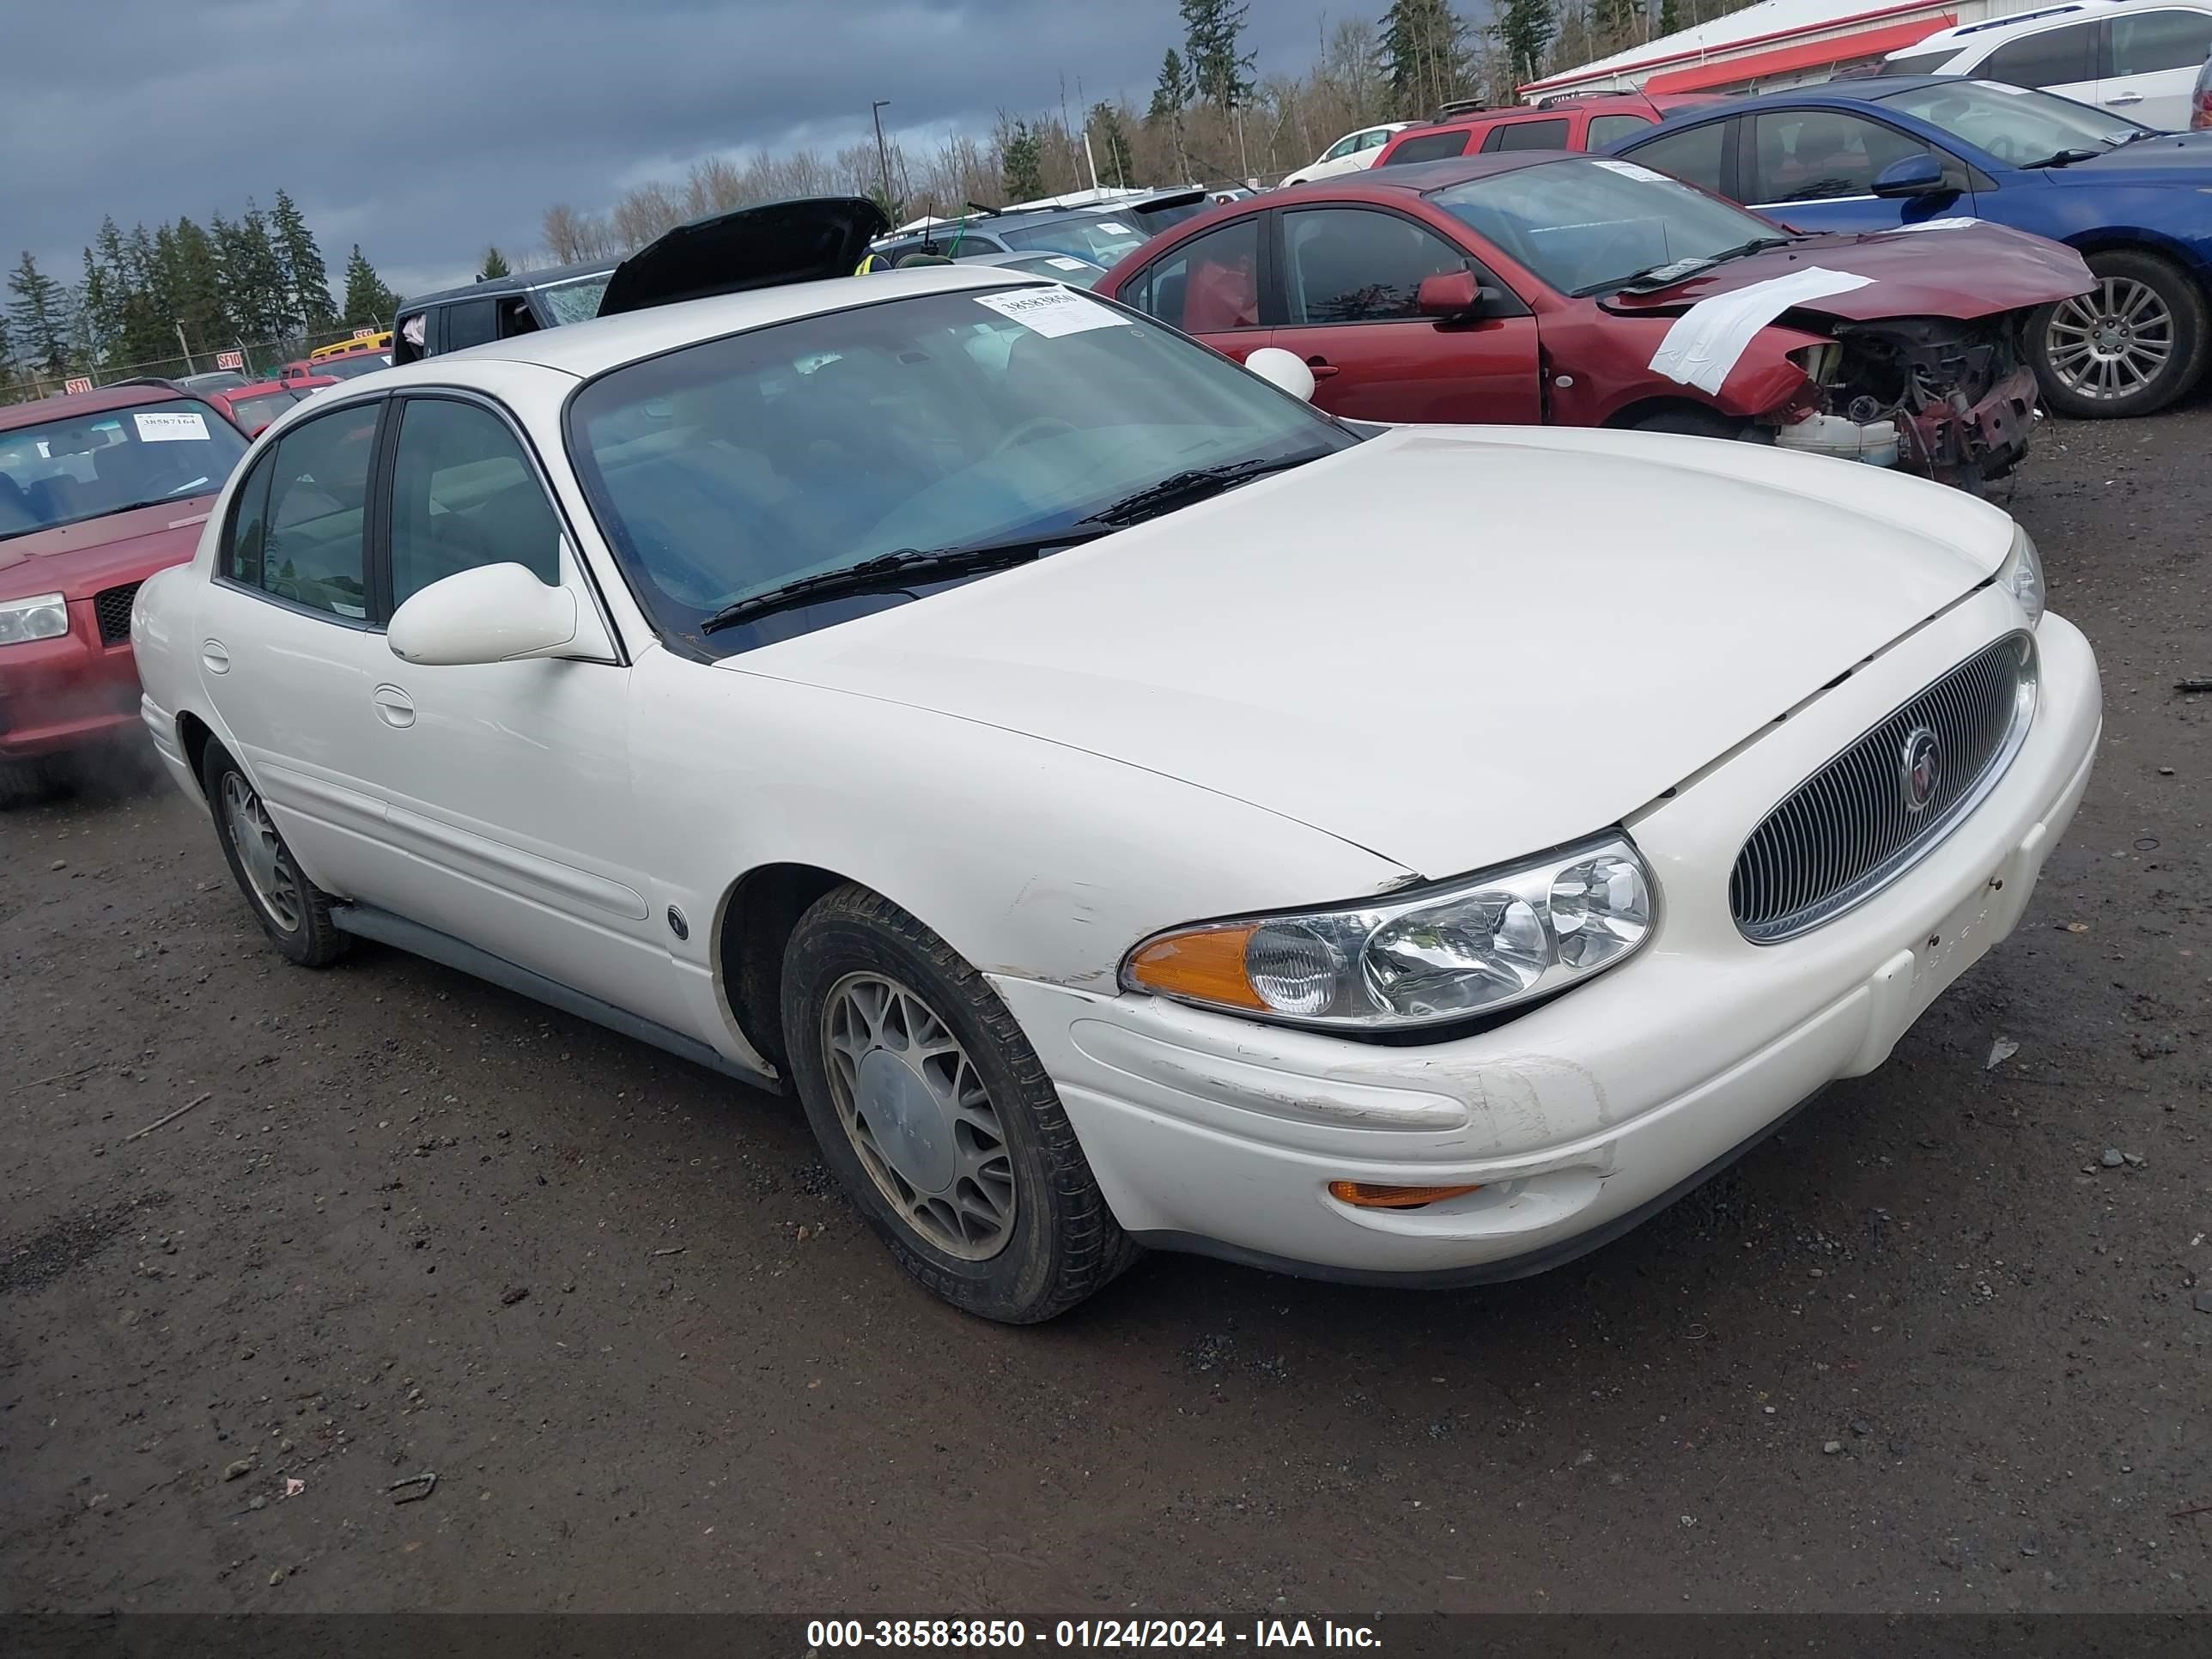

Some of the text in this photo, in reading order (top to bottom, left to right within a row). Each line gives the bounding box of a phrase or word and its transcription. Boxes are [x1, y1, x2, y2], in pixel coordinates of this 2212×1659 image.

[1001, 294, 1078, 313] 38583850
[219, 353, 241, 368] SF10
[69, 380, 90, 394] SF11
